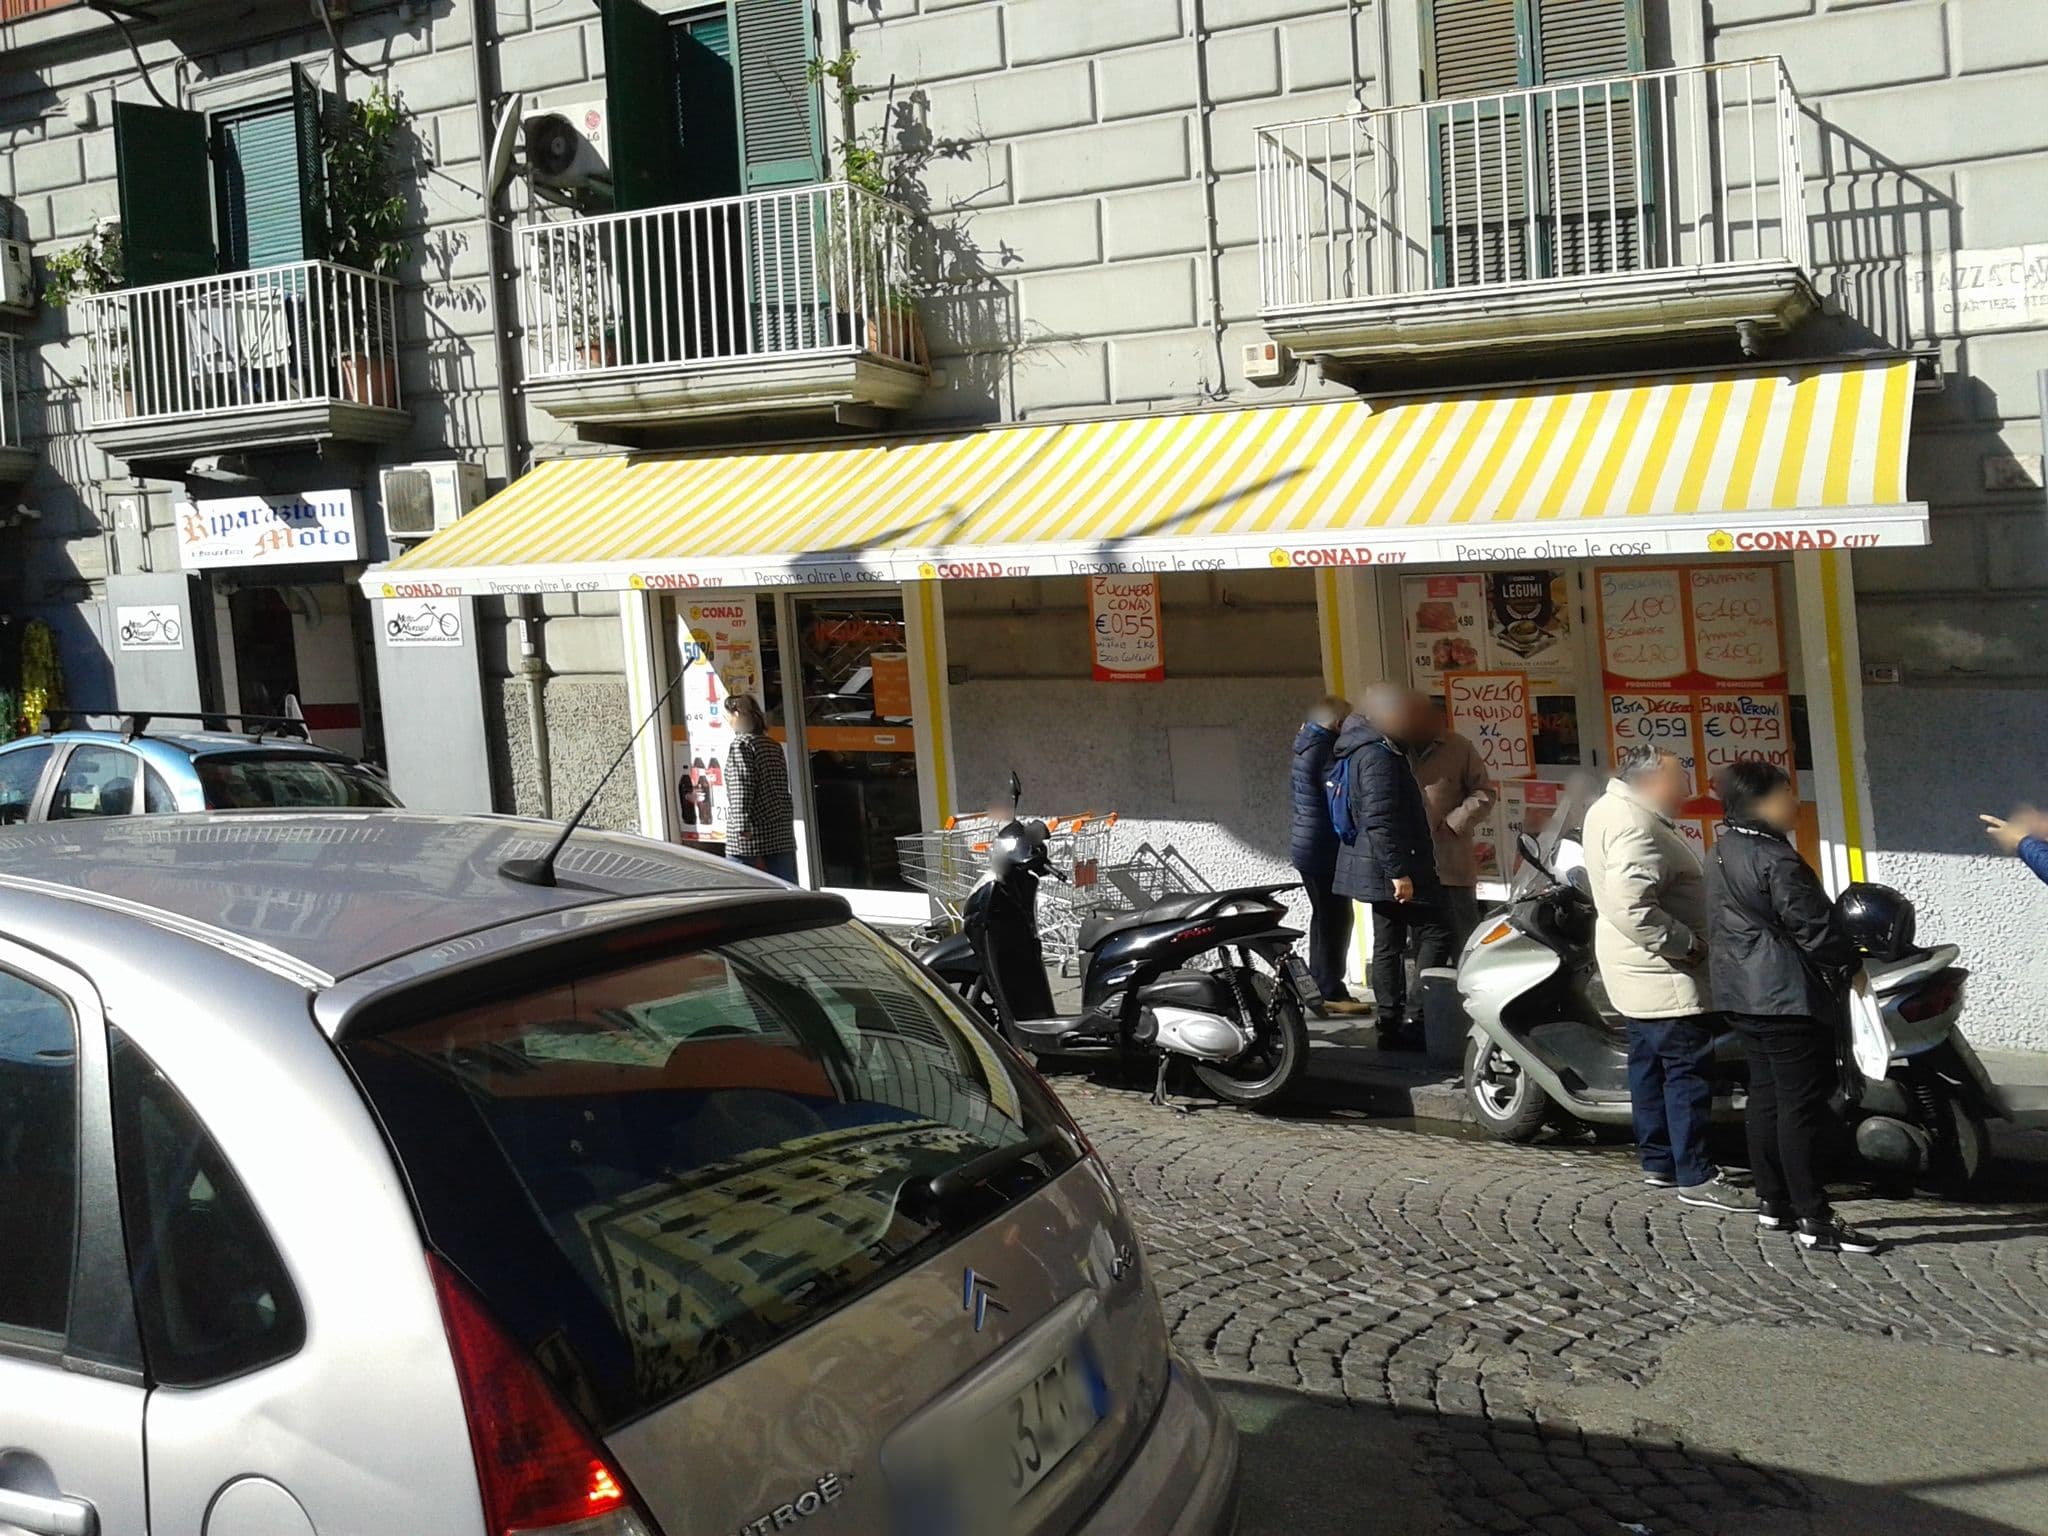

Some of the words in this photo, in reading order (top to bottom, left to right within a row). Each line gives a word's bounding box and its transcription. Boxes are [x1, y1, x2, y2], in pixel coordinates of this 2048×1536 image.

[182, 500, 346, 544] Riparazioni
[253, 527, 350, 558] Moto
[1736, 530, 1837, 550] CONAD
[1843, 534, 1880, 547] CITY
[1292, 548, 1372, 565] CONAD
[1377, 552, 1406, 563] CITY
[1456, 544, 1526, 561] Persone
[1534, 540, 1577, 559] oltre
[1585, 539, 1601, 557] le
[1610, 542, 1651, 556] cose
[937, 562, 1002, 578] CONAD
[1007, 566, 1030, 577] CITY
[1069, 559, 1126, 574] Persone
[1172, 555, 1185, 572] le
[645, 573, 699, 588] CONAD
[703, 577, 722, 587] CITY
[755, 571, 804, 586] Persone
[840, 568, 849, 583] le
[395, 583, 442, 597] CONAD
[1094, 577, 1153, 596] ZUCCHERO
[1502, 583, 1543, 598] LEGUMI
[702, 606, 743, 618] CONAD
[1108, 599, 1151, 615] CONAD
[1452, 678, 1523, 703] SVELTO
[1454, 705, 1523, 722] LIQUIDO
[1700, 697, 1740, 714] BIRRA
[1482, 737, 1529, 770] 2,99
